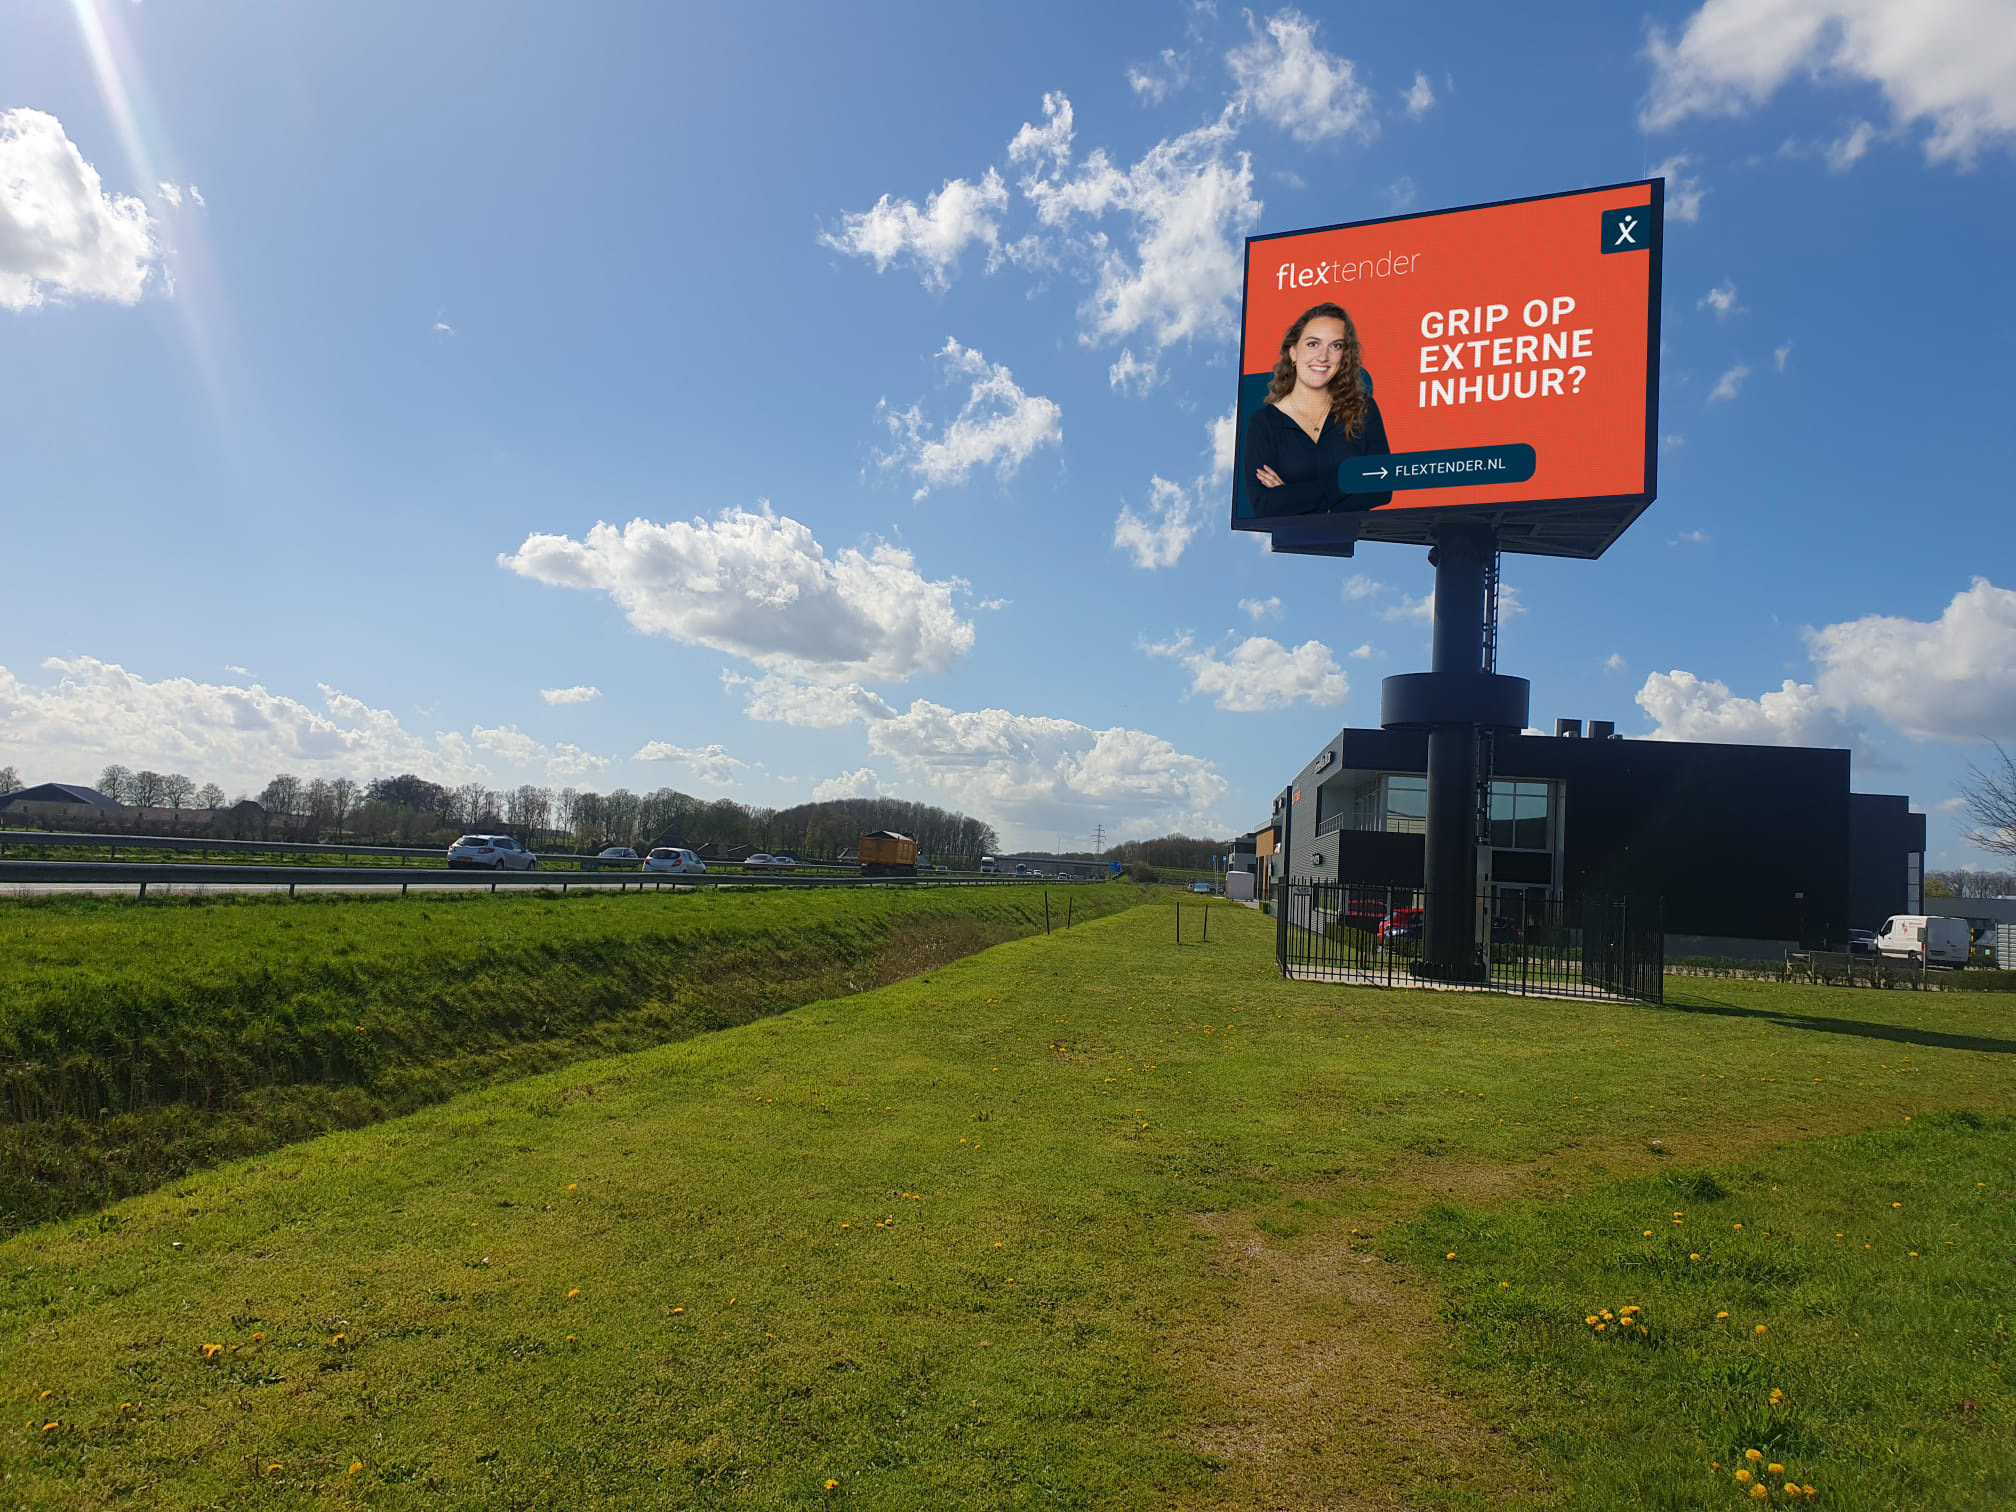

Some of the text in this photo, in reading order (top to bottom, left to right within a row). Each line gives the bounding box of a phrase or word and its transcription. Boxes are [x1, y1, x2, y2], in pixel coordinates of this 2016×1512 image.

[1275, 250, 1421, 291] flextender
[1420, 296, 1576, 339] GRIP OP
[1420, 328, 1593, 374] EXTERNE
[1419, 365, 1587, 408] INHUUR?
[1395, 458, 1506, 477] FLEXTENDER.NL
